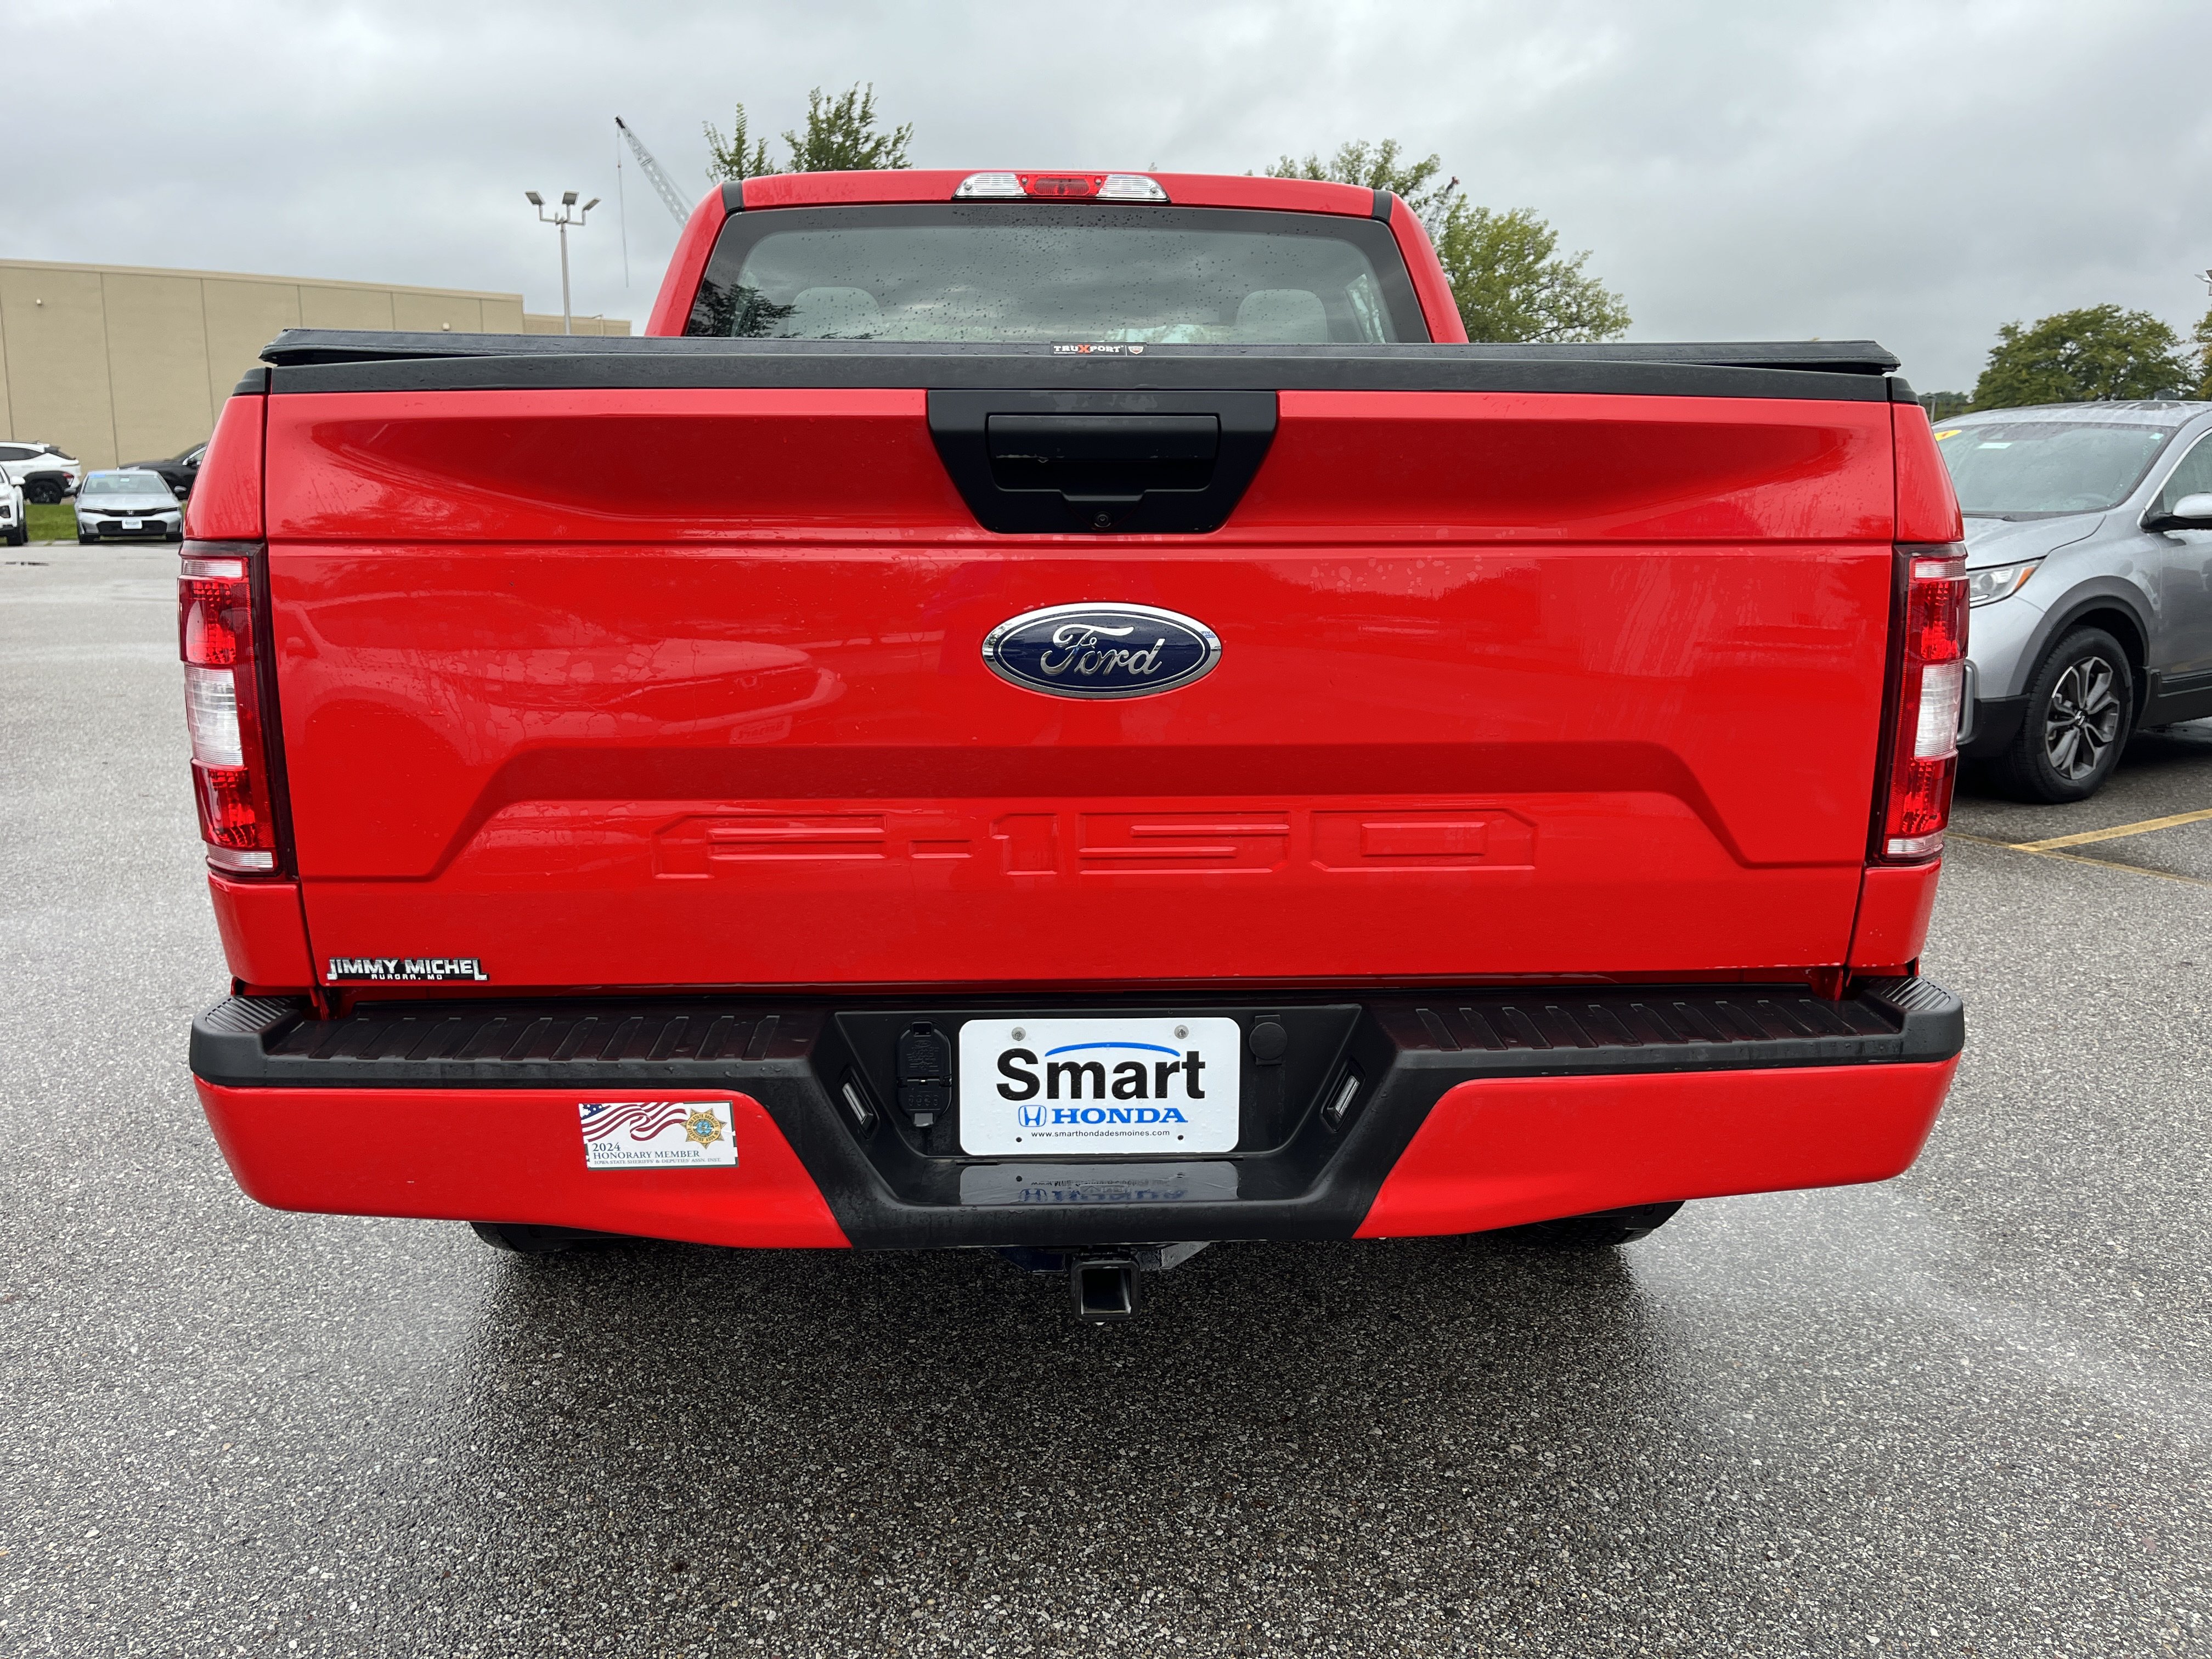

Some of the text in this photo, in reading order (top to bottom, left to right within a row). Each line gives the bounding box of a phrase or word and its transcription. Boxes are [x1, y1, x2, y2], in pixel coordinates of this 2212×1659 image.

[1053, 344, 1121, 354] TRUXPORT
[1041, 624, 1166, 676] Ford
[654, 808, 1536, 878] F-150
[327, 959, 488, 980] JIMMY MICHEL
[996, 1048, 1206, 1101] Smart
[1051, 1108, 1189, 1124] HONDA
[592, 1142, 621, 1152] 2024
